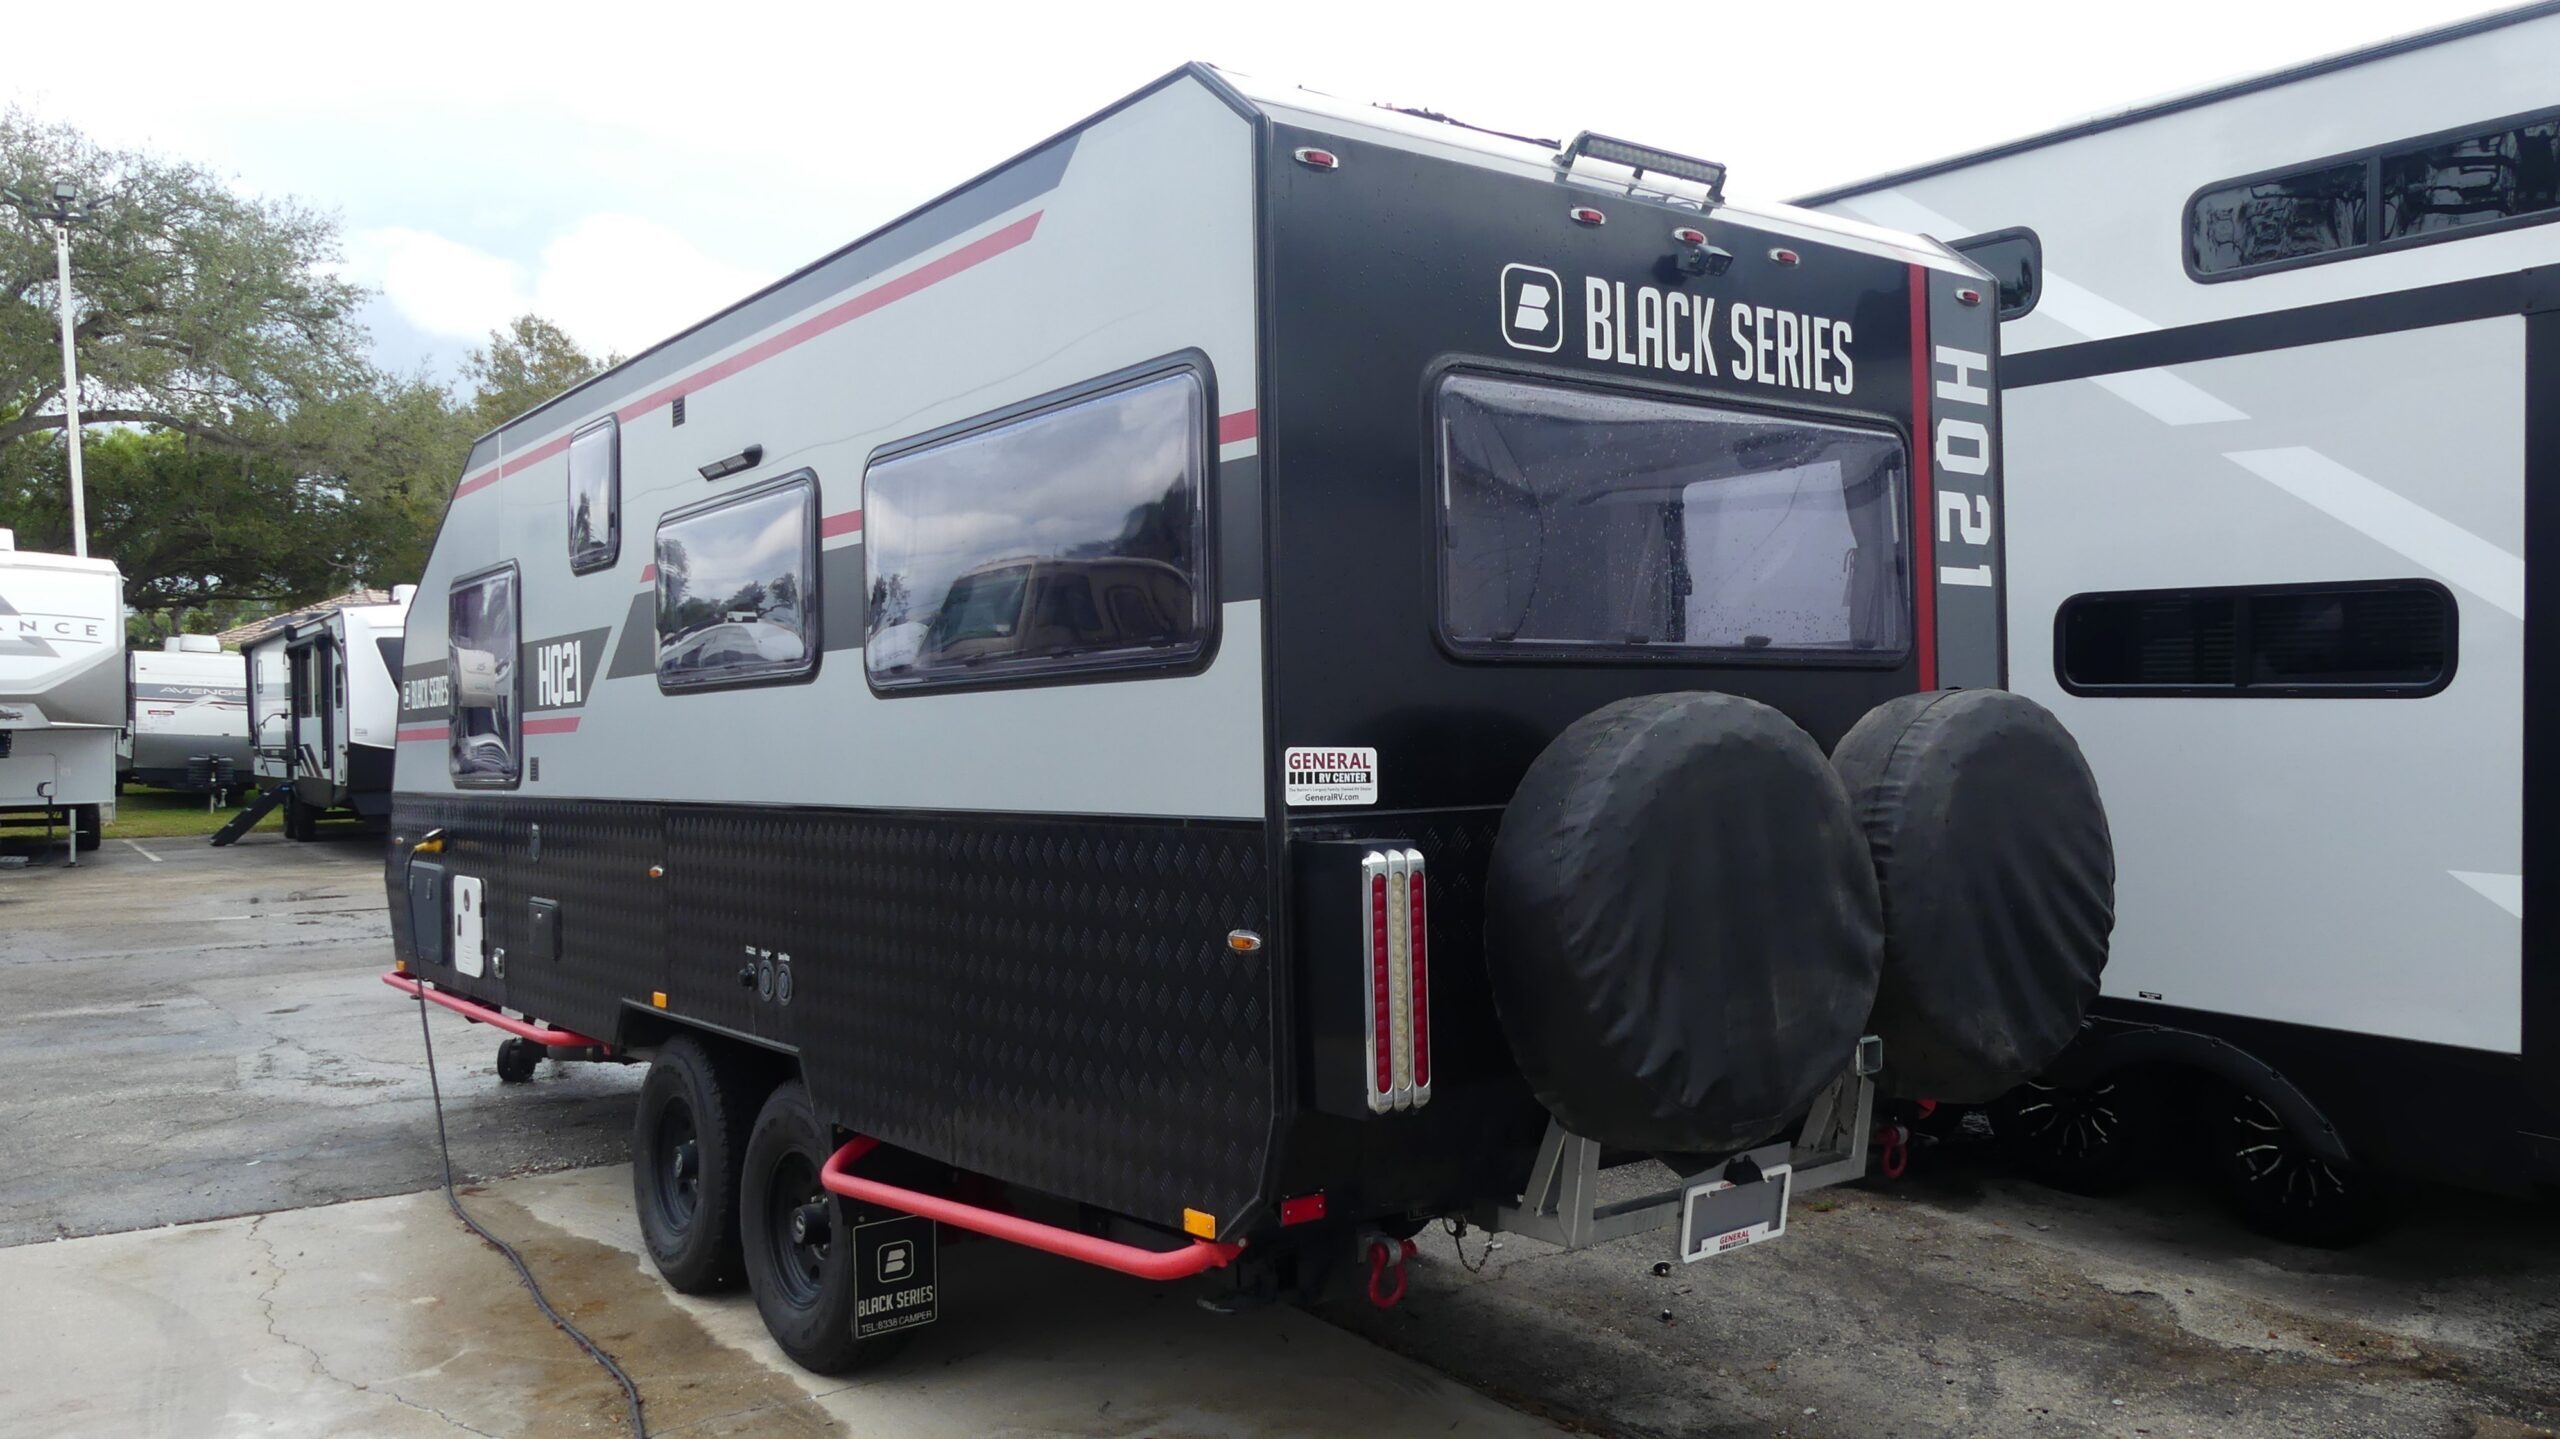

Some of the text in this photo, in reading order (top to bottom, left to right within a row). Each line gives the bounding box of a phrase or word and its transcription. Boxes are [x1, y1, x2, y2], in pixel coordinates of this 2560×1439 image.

[1585, 275, 1854, 395] BLACK SERIES
[1934, 344, 1993, 588] HQ21
[0, 620, 99, 637] NCE
[538, 639, 582, 707] HQ21
[1288, 752, 1371, 770] GENERAL
[1319, 772, 1367, 783] RV CENTER
[1305, 793, 1360, 802] GeneralRV.com
[1720, 1230, 1749, 1245] GENERAL
[858, 1285, 934, 1318] BLACK SERIES
[899, 1310, 933, 1326] CAMPER
